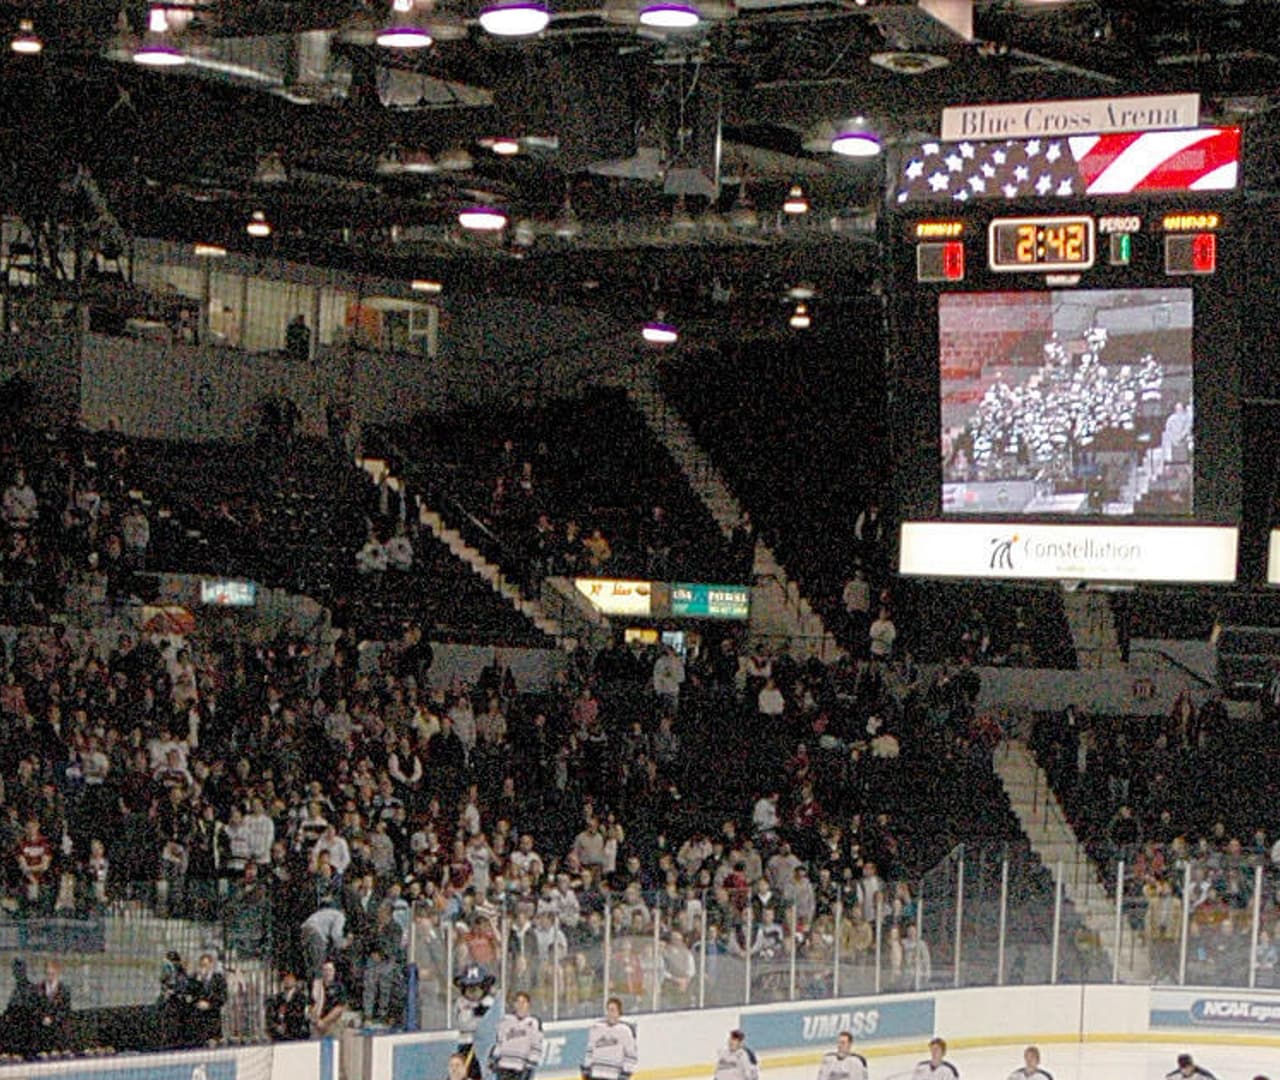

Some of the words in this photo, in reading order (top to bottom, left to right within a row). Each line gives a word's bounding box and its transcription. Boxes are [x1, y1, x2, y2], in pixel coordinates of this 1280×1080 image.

[961, 110, 1016, 137] Blue
[1024, 106, 1092, 133] Cross
[1104, 102, 1179, 127] Arena
[1016, 224, 1086, 263] 2:42
[1024, 537, 1142, 561] Constellation
[802, 1009, 879, 1040] UMASS
